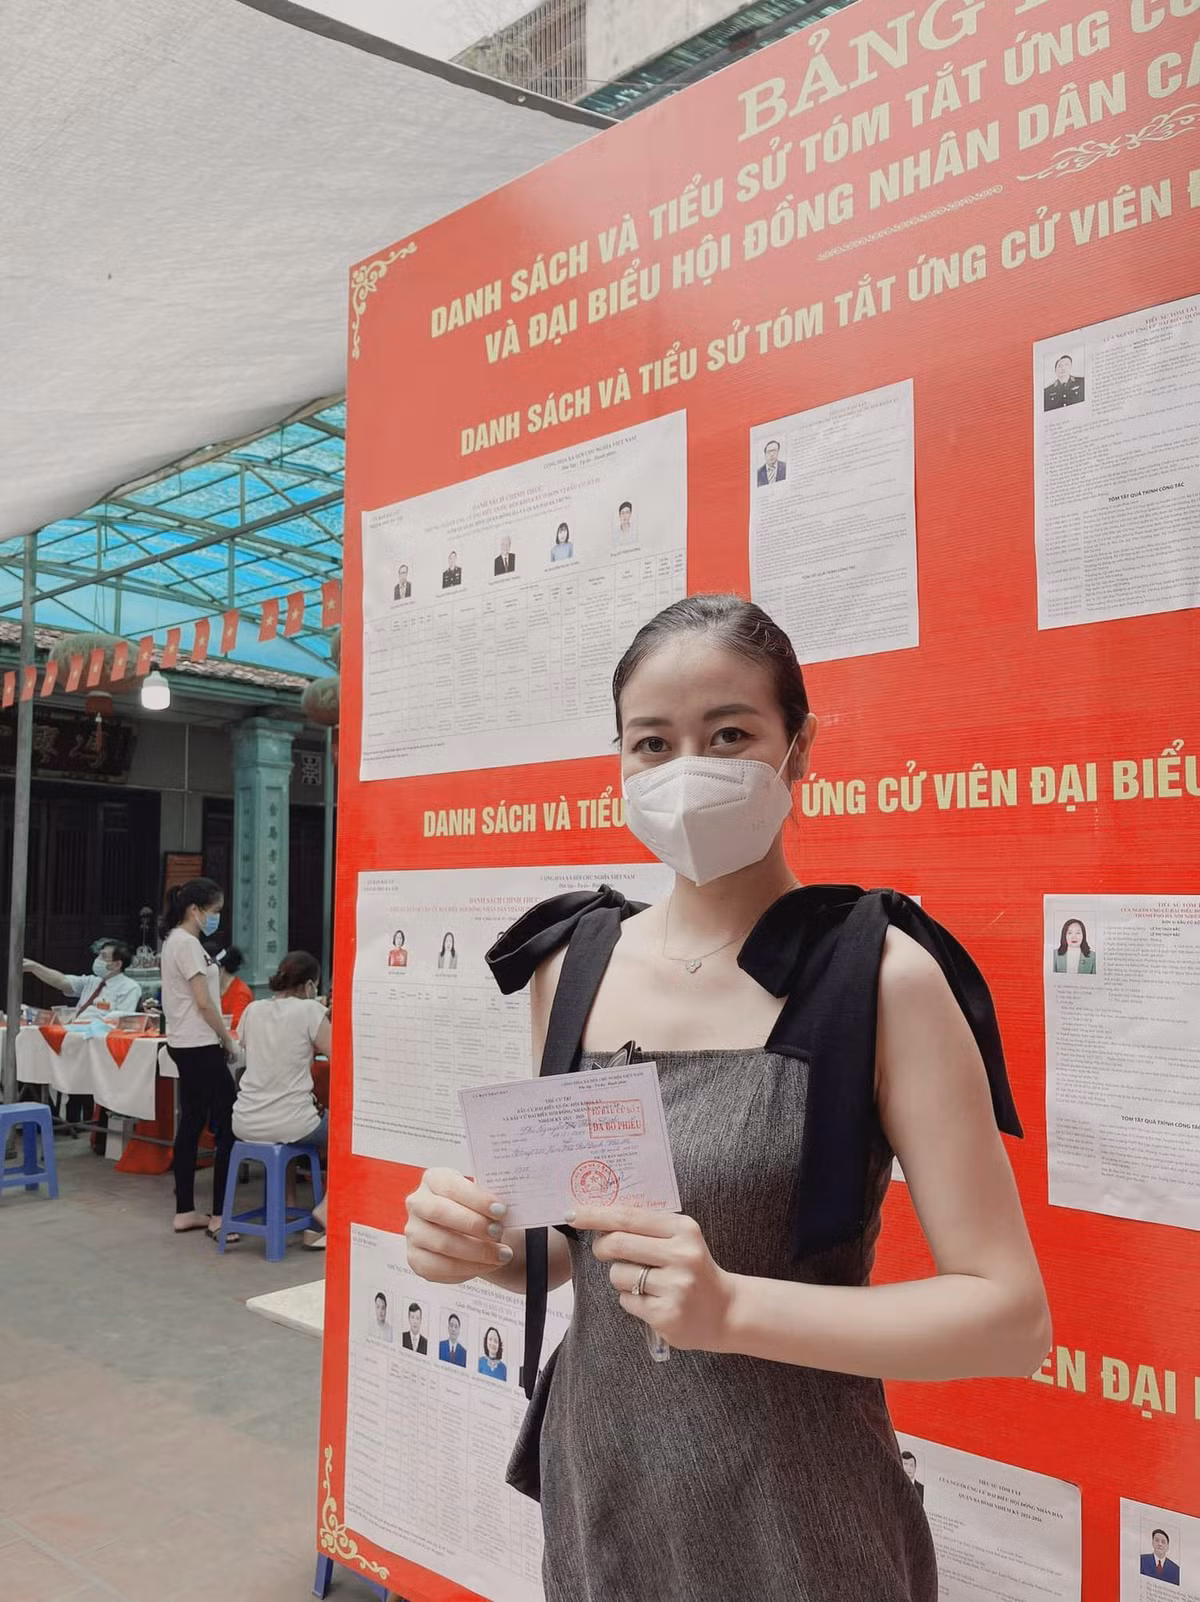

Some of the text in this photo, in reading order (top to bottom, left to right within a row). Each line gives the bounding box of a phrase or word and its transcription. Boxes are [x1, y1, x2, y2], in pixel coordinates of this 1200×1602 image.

[737, 0, 986, 142] BẢNG
[431, 280, 501, 338] DANH
[510, 241, 588, 303] SÁCH
[597, 212, 639, 264] VÀ
[648, 173, 724, 241] TIỂU
[736, 136, 792, 203] SỬ
[800, 102, 890, 174] TÓM
[905, 59, 988, 128] TẮT
[1004, 10, 1110, 86] ỨNG
[485, 318, 521, 364] VÀ
[528, 298, 578, 347] ĐẠI
[588, 258, 661, 325] BIỂU
[672, 234, 731, 288] HỘI
[743, 183, 854, 261] ĐỒNG
[870, 120, 1000, 209] NHÂN
[1018, 71, 1127, 152] DÂN
[461, 411, 520, 457] DANH
[527, 386, 591, 433] SÁCH
[598, 367, 631, 409] VÀ
[639, 341, 697, 394] TIỂU
[707, 319, 751, 372] SỬ
[756, 302, 824, 355] TÓM
[833, 273, 896, 328] TẮT
[907, 244, 987, 302] ỨNG
[1001, 205, 1061, 270] CỬ
[1070, 178, 1172, 247] VIÊN
[423, 785, 627, 838] DANH SÁCH VÀ TIỂU
[801, 772, 867, 817] ỨNG
[877, 760, 927, 814] CỬ
[933, 762, 1018, 811] VIÊN
[1029, 762, 1098, 812] ĐẠI
[1100, 1355, 1176, 1419] ĐẠI
